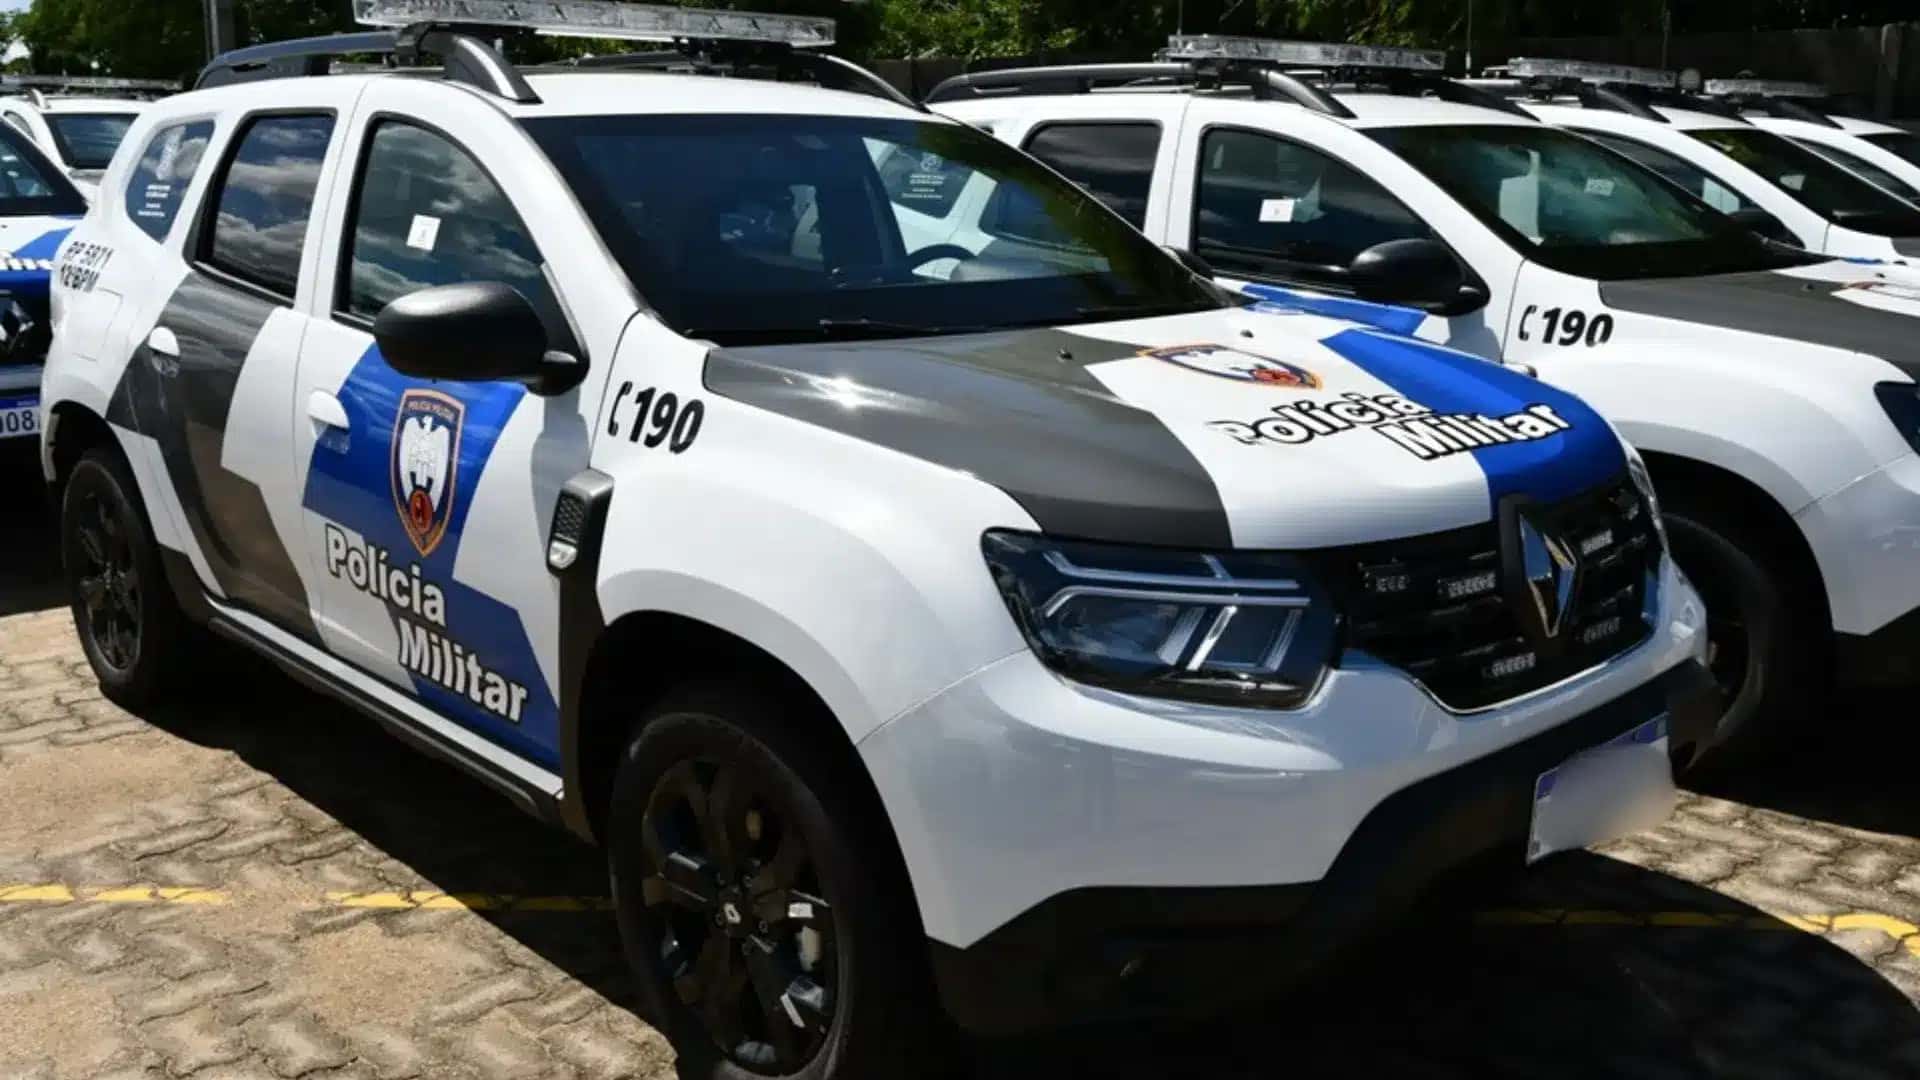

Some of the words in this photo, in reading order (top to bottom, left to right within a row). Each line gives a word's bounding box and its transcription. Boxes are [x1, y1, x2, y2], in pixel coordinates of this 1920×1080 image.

[1541, 306, 1614, 348] 190
[629, 386, 704, 455] 190
[1204, 392, 1432, 445] Polícia
[1370, 402, 1571, 461] Militar
[325, 522, 447, 628] Polícia
[397, 616, 529, 723] Militar
